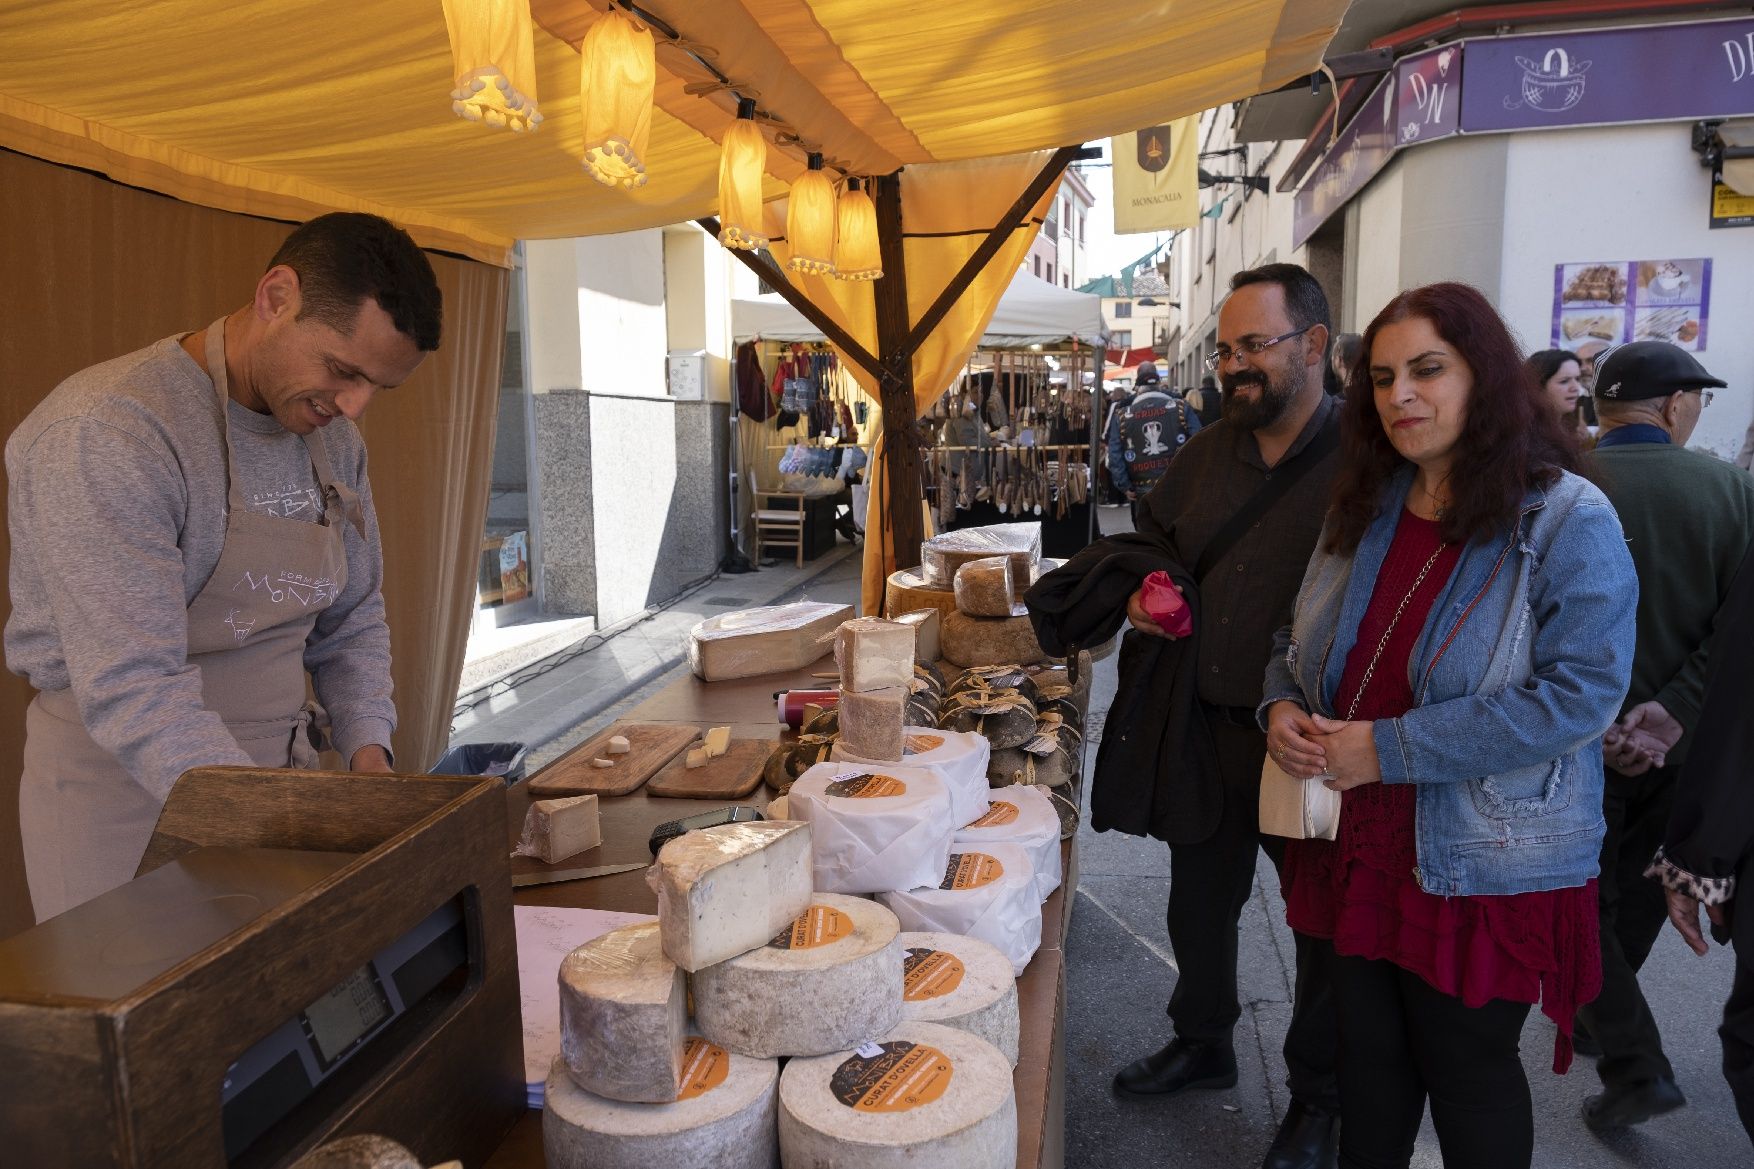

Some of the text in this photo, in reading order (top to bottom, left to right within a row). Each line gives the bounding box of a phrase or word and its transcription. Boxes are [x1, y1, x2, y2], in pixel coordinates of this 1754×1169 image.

[1408, 72, 1448, 124] DN
[1131, 191, 1183, 208] MONACALIA
[1134, 407, 1166, 420] GRUAS
[863, 1080, 892, 1106] CURAT
[889, 1048, 927, 1081] D'OVELLA
